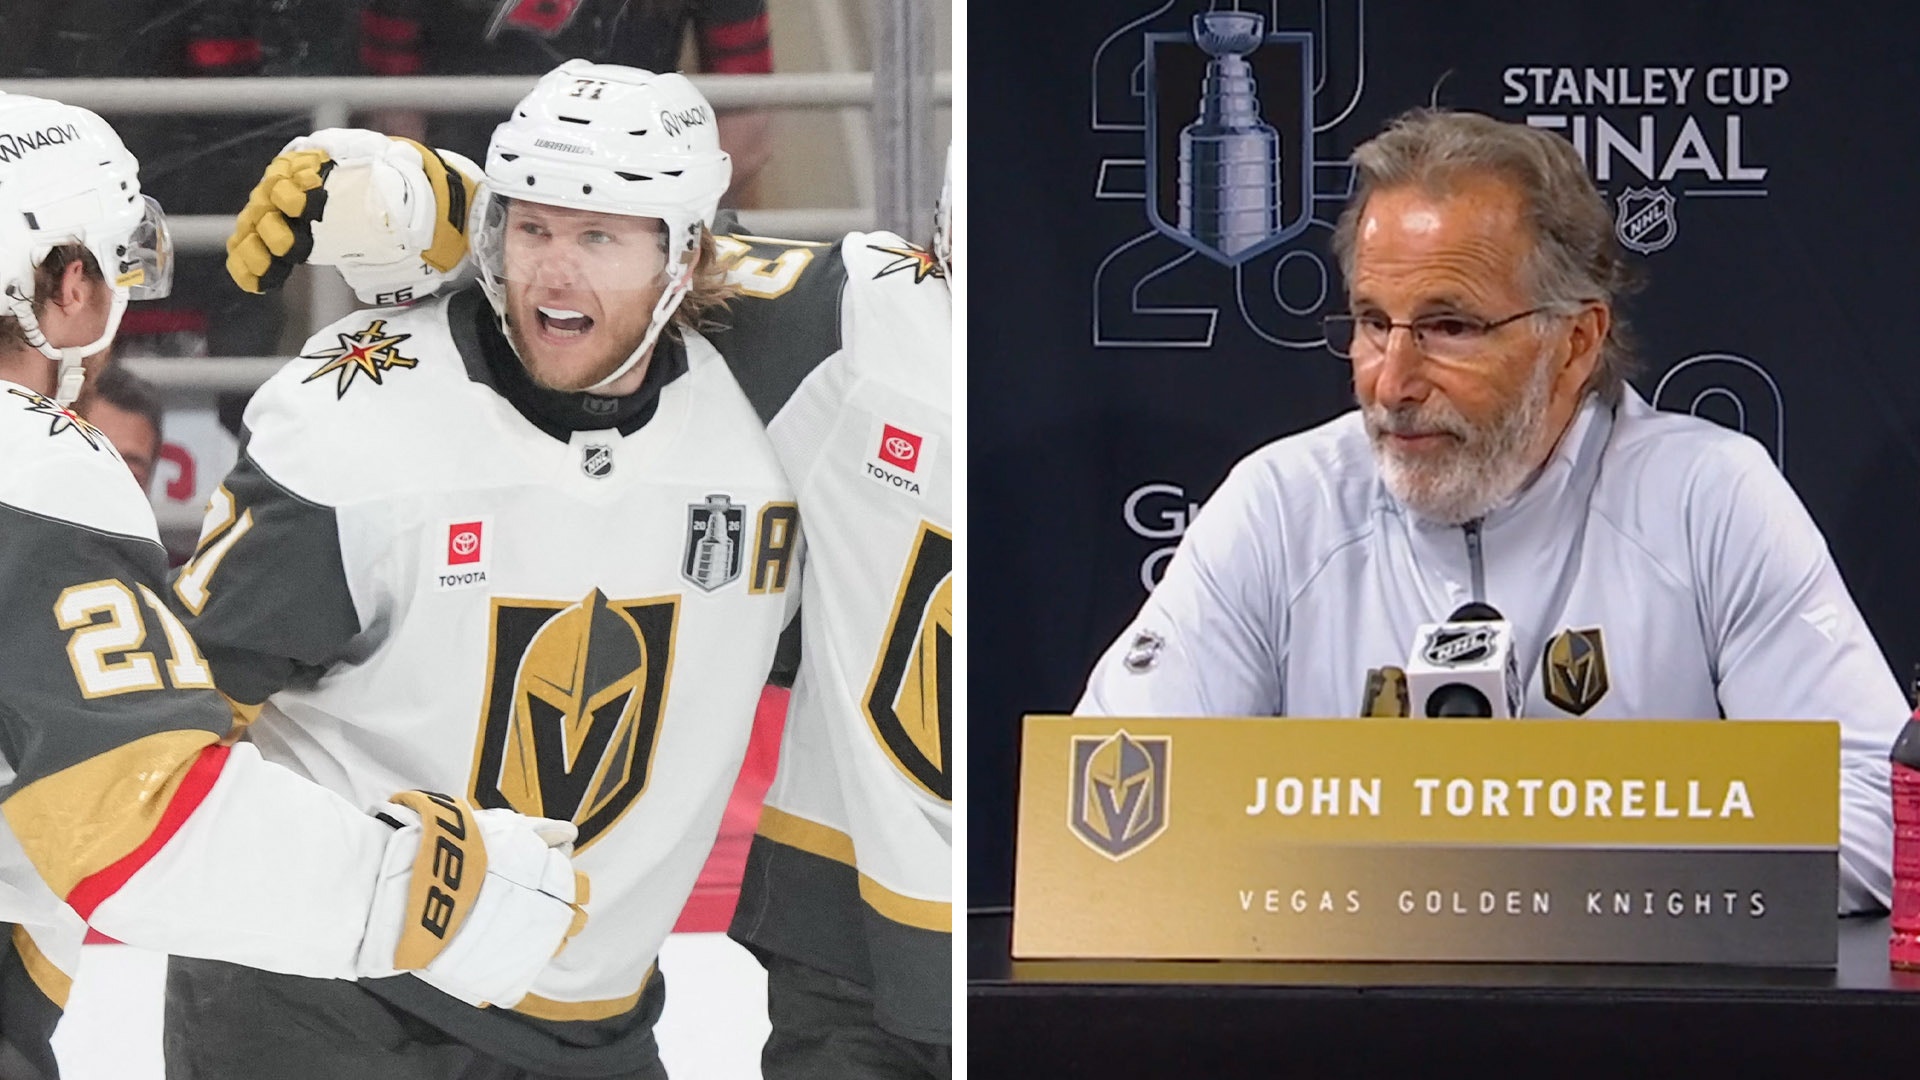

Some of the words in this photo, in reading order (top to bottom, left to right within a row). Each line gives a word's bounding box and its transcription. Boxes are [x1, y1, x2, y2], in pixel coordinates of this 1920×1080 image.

[568, 79, 608, 100] 71
[1503, 67, 1694, 105] STANLEY
[1706, 67, 1790, 105] CUP
[17, 124, 80, 153] NAQVI
[1527, 115, 1768, 181] INAL
[1630, 205, 1664, 238] NHL
[866, 463, 920, 495] TOYOTA
[748, 501, 798, 595] A
[439, 571, 486, 587] TOYOTA
[53, 578, 216, 700] 21
[1245, 777, 1381, 816] JOHN
[1413, 778, 1755, 818] TORTORELLA
[1239, 889, 1361, 913] VEGAS
[1398, 889, 1551, 915] GOLDEN
[1586, 891, 1766, 917] KNIGHTS
